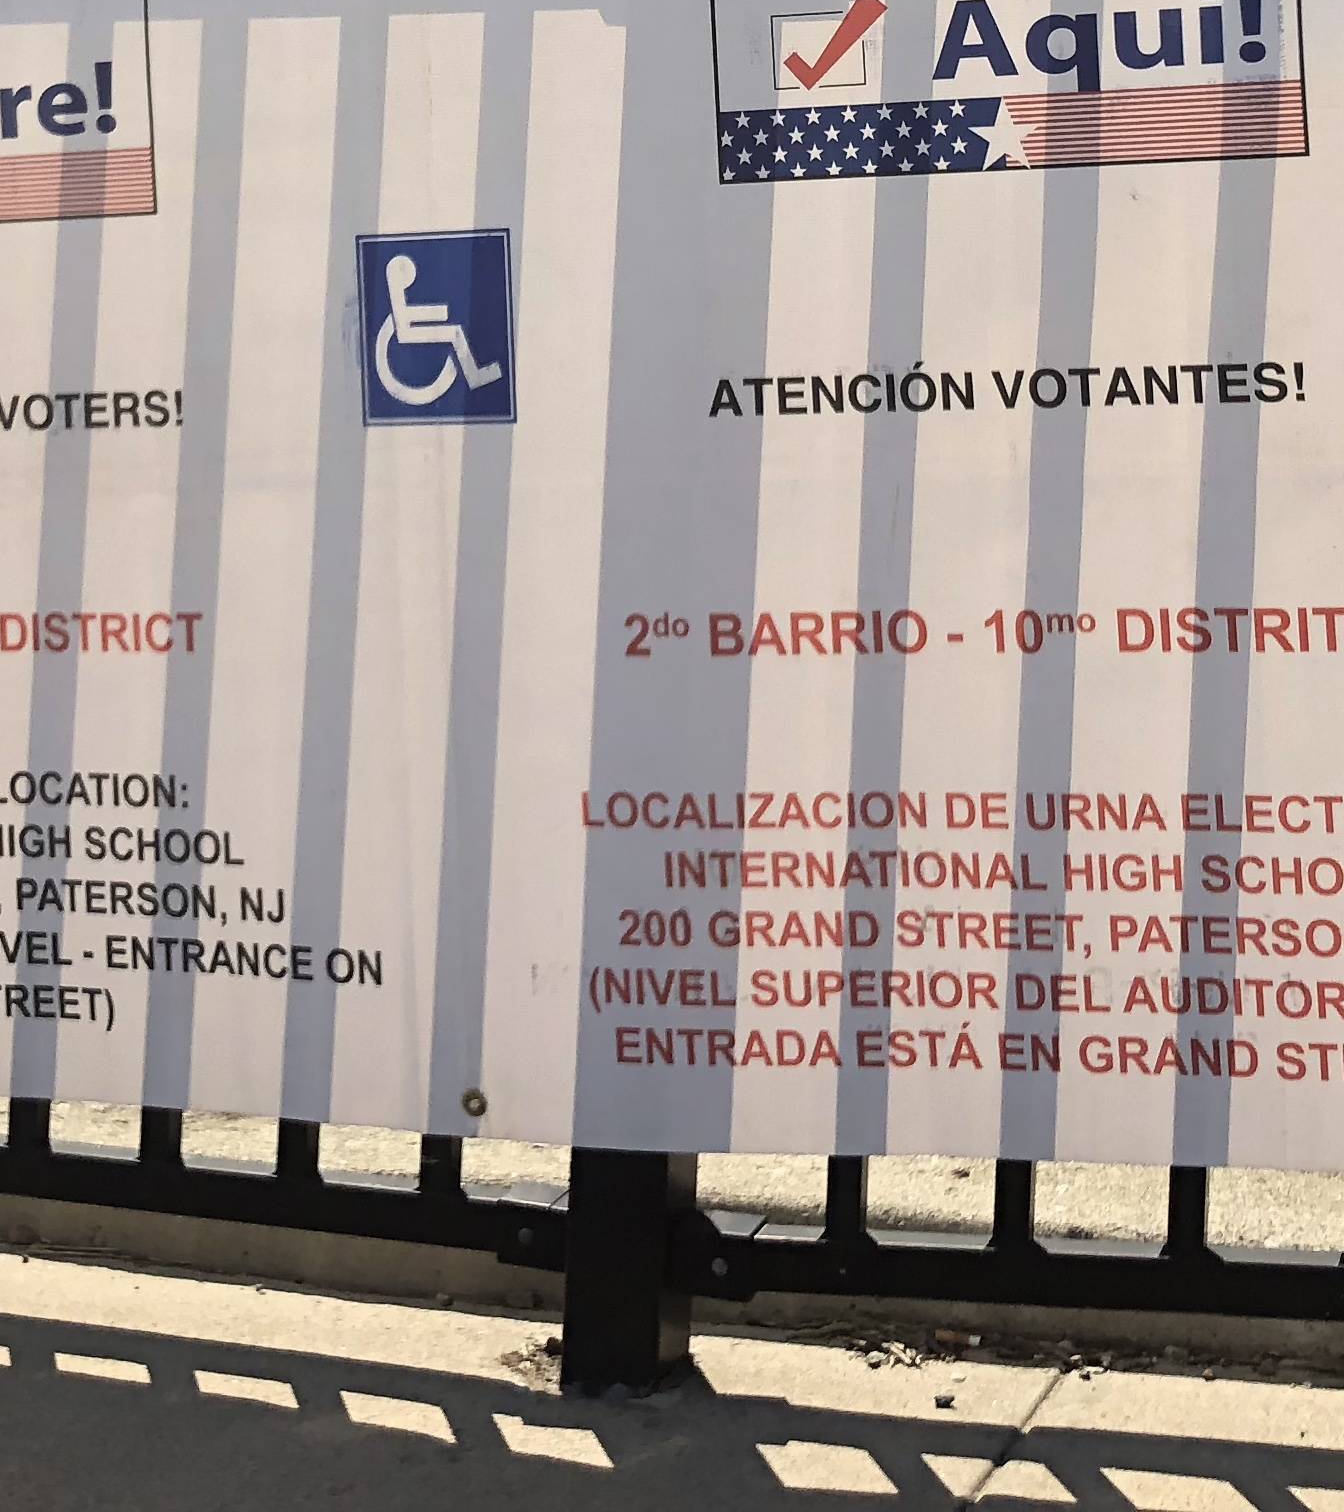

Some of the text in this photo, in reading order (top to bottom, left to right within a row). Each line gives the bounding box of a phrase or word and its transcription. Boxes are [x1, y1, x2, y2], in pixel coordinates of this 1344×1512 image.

[708, 361, 1307, 418] ATENCIÓN VOTANTES!
[0, 611, 204, 654] DISTRICT
[623, 611, 690, 658] 2do
[709, 609, 929, 657] BARRIO
[946, 632, 965, 642] -
[984, 609, 1097, 655] 10mo
[581, 791, 928, 831] LOCALIZACION
[945, 792, 1010, 831] DE
[1025, 792, 1167, 832] URNA
[84, 825, 245, 866] SCHOOL
[663, 849, 1048, 891] INTERNATIONAL
[1062, 852, 1184, 892] HIGH
[15, 877, 228, 927] PATERSON,
[239, 887, 285, 924] NJ
[618, 908, 692, 948] 200
[707, 910, 881, 949] GRAND
[896, 910, 1092, 959] STREET,
[106, 934, 315, 982] ENTRANCE
[326, 948, 383, 987] ON
[588, 965, 737, 1014] (NIVEL
[750, 969, 999, 1010] SUPERIOR
[1015, 972, 1111, 1014] DEL
[615, 1026, 843, 1068] ENTRADA
[856, 1021, 983, 1070] ESTÁ
[998, 1033, 1062, 1073] EN
[1078, 1035, 1259, 1080] GRAND
